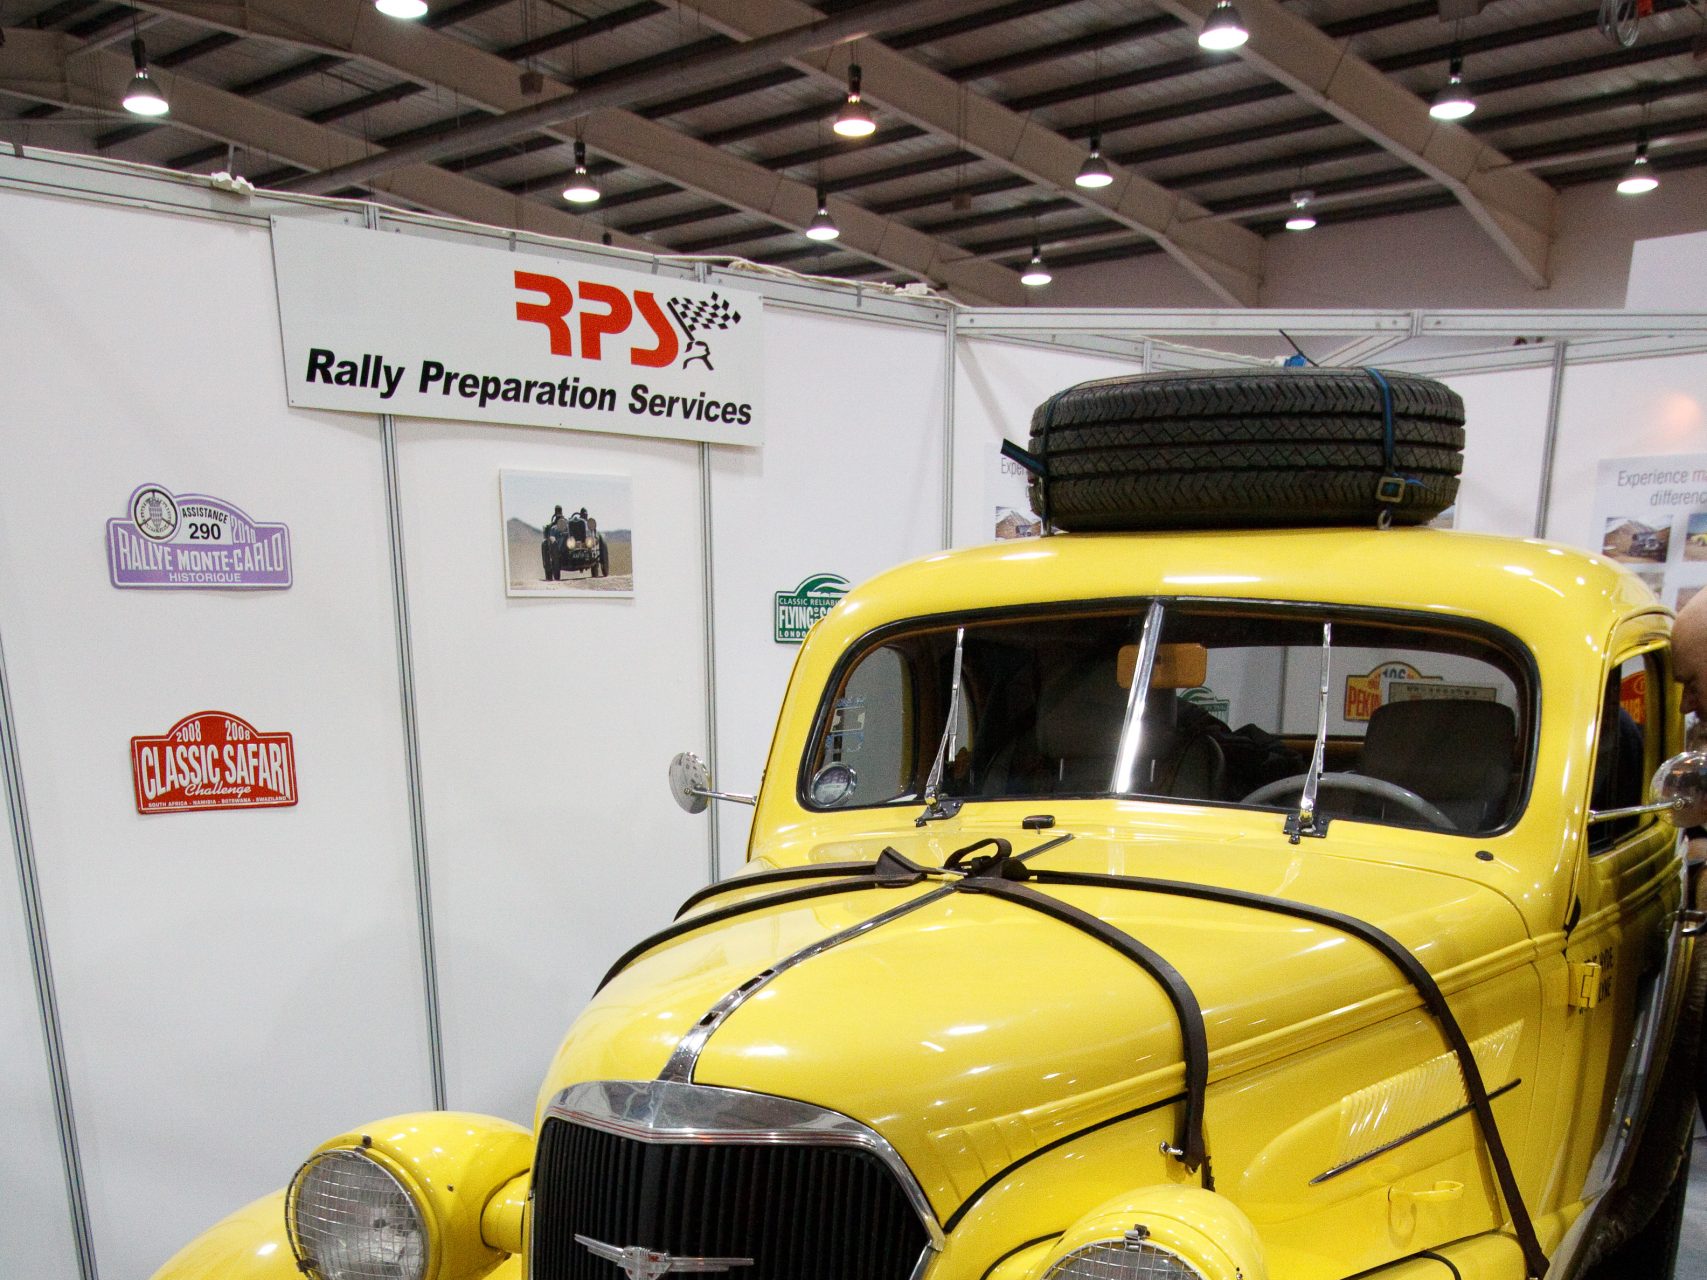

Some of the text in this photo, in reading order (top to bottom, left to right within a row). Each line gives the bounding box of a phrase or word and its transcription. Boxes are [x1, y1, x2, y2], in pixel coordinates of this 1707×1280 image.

[514, 270, 679, 368] RPS
[306, 348, 753, 425] Rally Preparation Services
[1618, 469, 1689, 487] Experience
[181, 507, 228, 524] ASSISTANCE
[188, 523, 221, 540] 290
[231, 517, 257, 544] 2010
[117, 527, 284, 572] RALLYE MONTE-CARLO
[169, 572, 241, 582] HISTORIQUE
[779, 597, 808, 605] CLASSIC
[779, 606, 814, 629] FLYING
[176, 720, 250, 743] 2008 2008
[141, 743, 290, 800] CLASSIC SAFARI
[185, 780, 252, 799] Challenge
